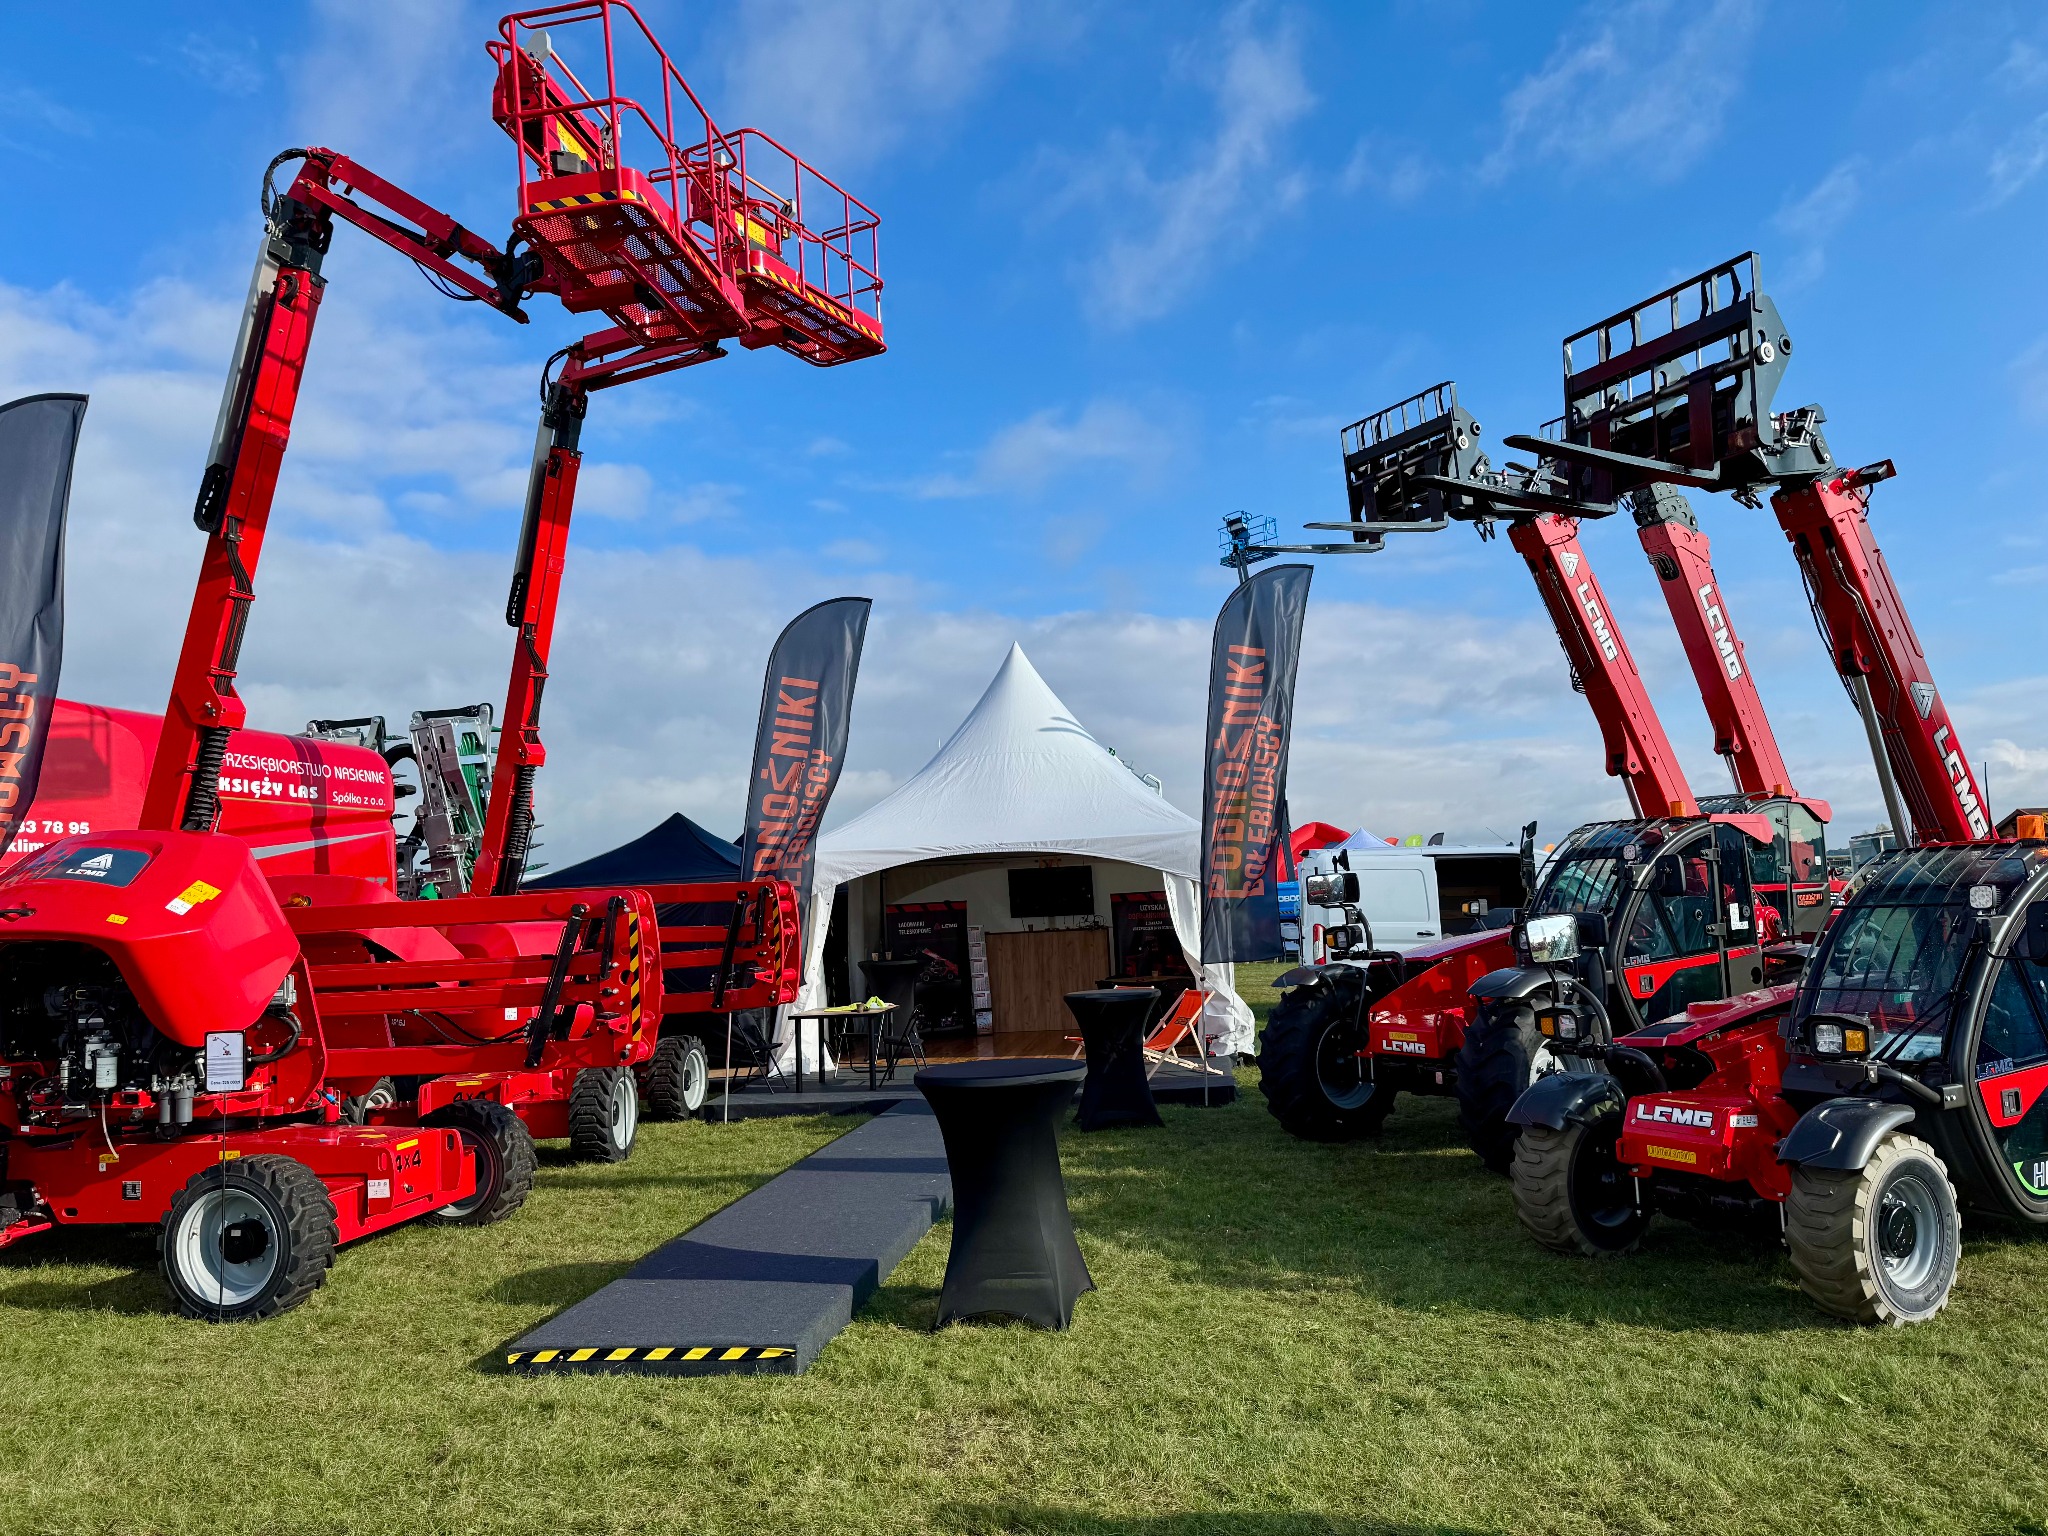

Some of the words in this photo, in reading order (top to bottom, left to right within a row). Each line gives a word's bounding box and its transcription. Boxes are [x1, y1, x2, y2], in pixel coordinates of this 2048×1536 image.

[223, 752, 332, 778] RZESIĘBIORSTWO
[334, 766, 386, 784] NASIENNE
[219, 777, 283, 799] KSIĘŻY
[288, 783, 319, 799] LAS
[332, 790, 362, 805] Spółka
[363, 797, 369, 805] z
[370, 797, 386, 806] o.o.
[42, 820, 64, 834] 78
[69, 821, 90, 835] 95
[396, 1149, 421, 1173] 4x4
